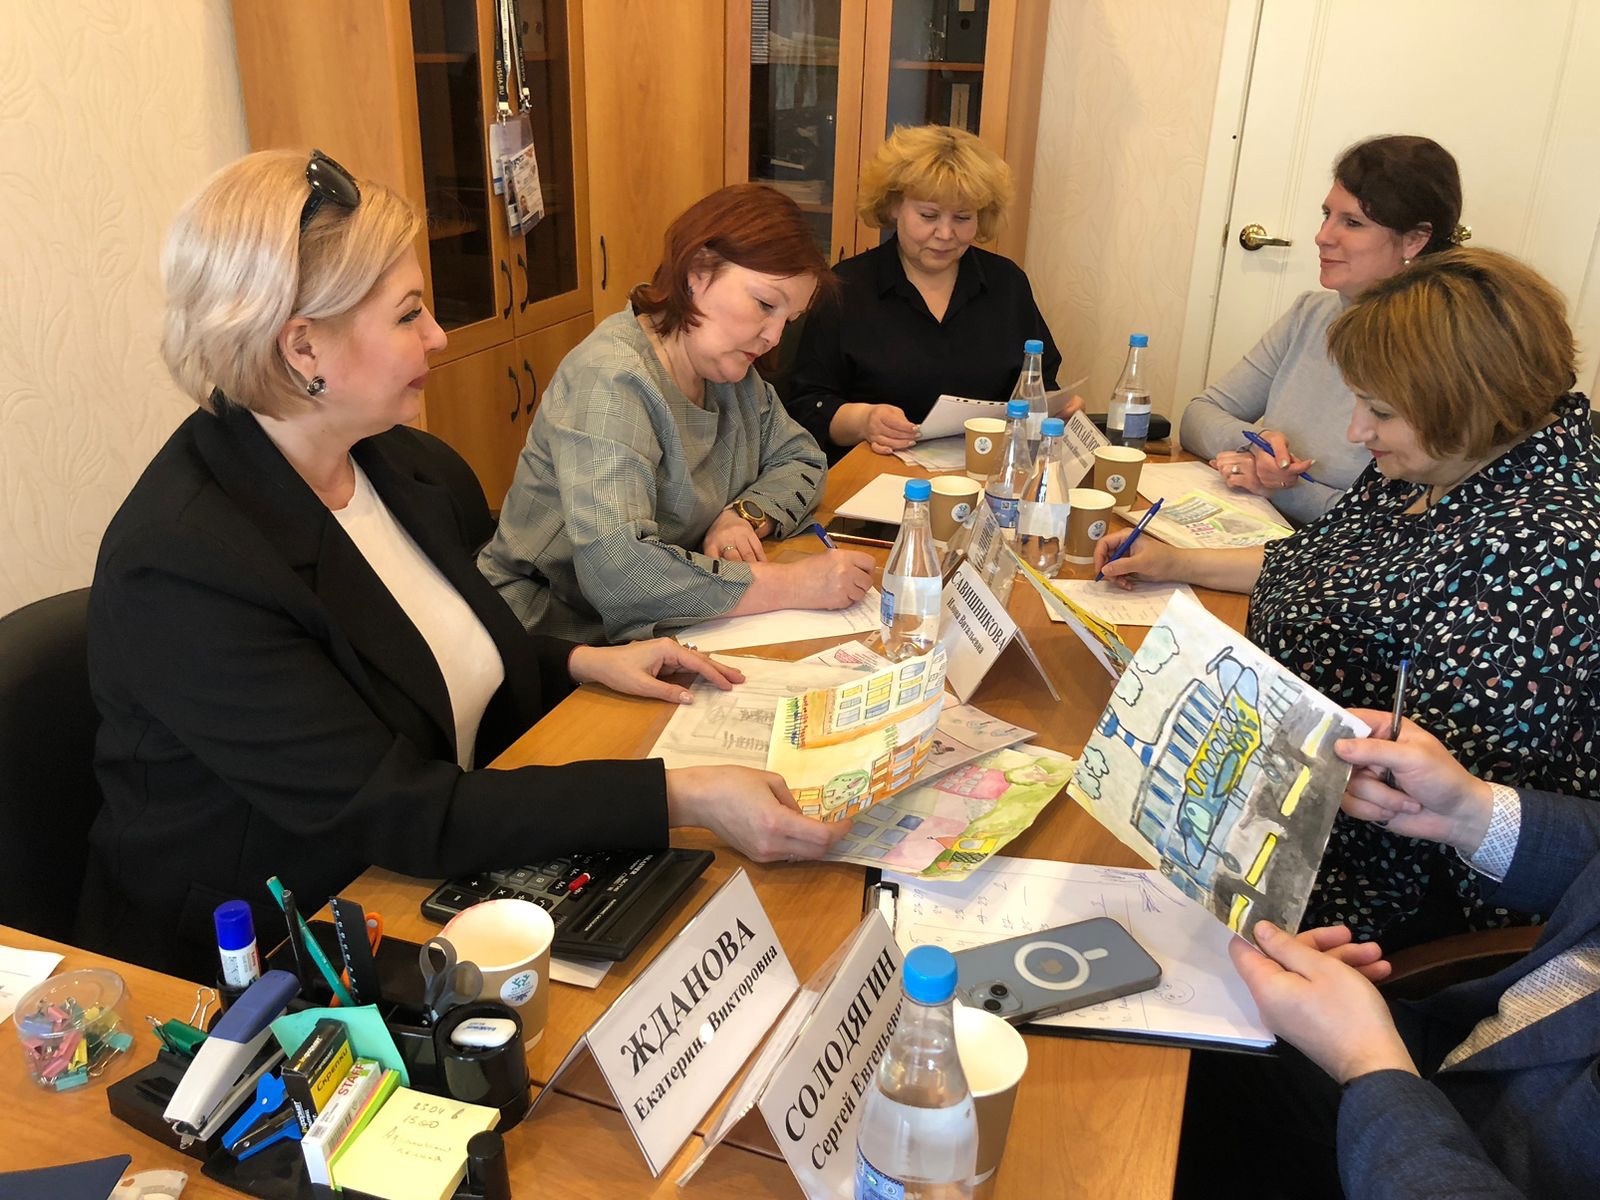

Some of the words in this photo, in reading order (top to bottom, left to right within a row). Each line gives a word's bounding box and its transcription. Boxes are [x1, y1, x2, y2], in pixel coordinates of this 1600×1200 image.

[951, 571, 1008, 649] САВИШНИКОВА
[958, 615, 985, 655] Витальевна
[620, 917, 756, 1077] ЖДАНОВА
[633, 1029, 709, 1121] Екатерин
[707, 946, 778, 1032] Викторовна
[316, 1047, 348, 1092] Скрепки
[338, 1063, 364, 1096] STAFF
[783, 946, 897, 1143] СОЛОДЯГИН
[811, 1096, 855, 1170] Сергей
